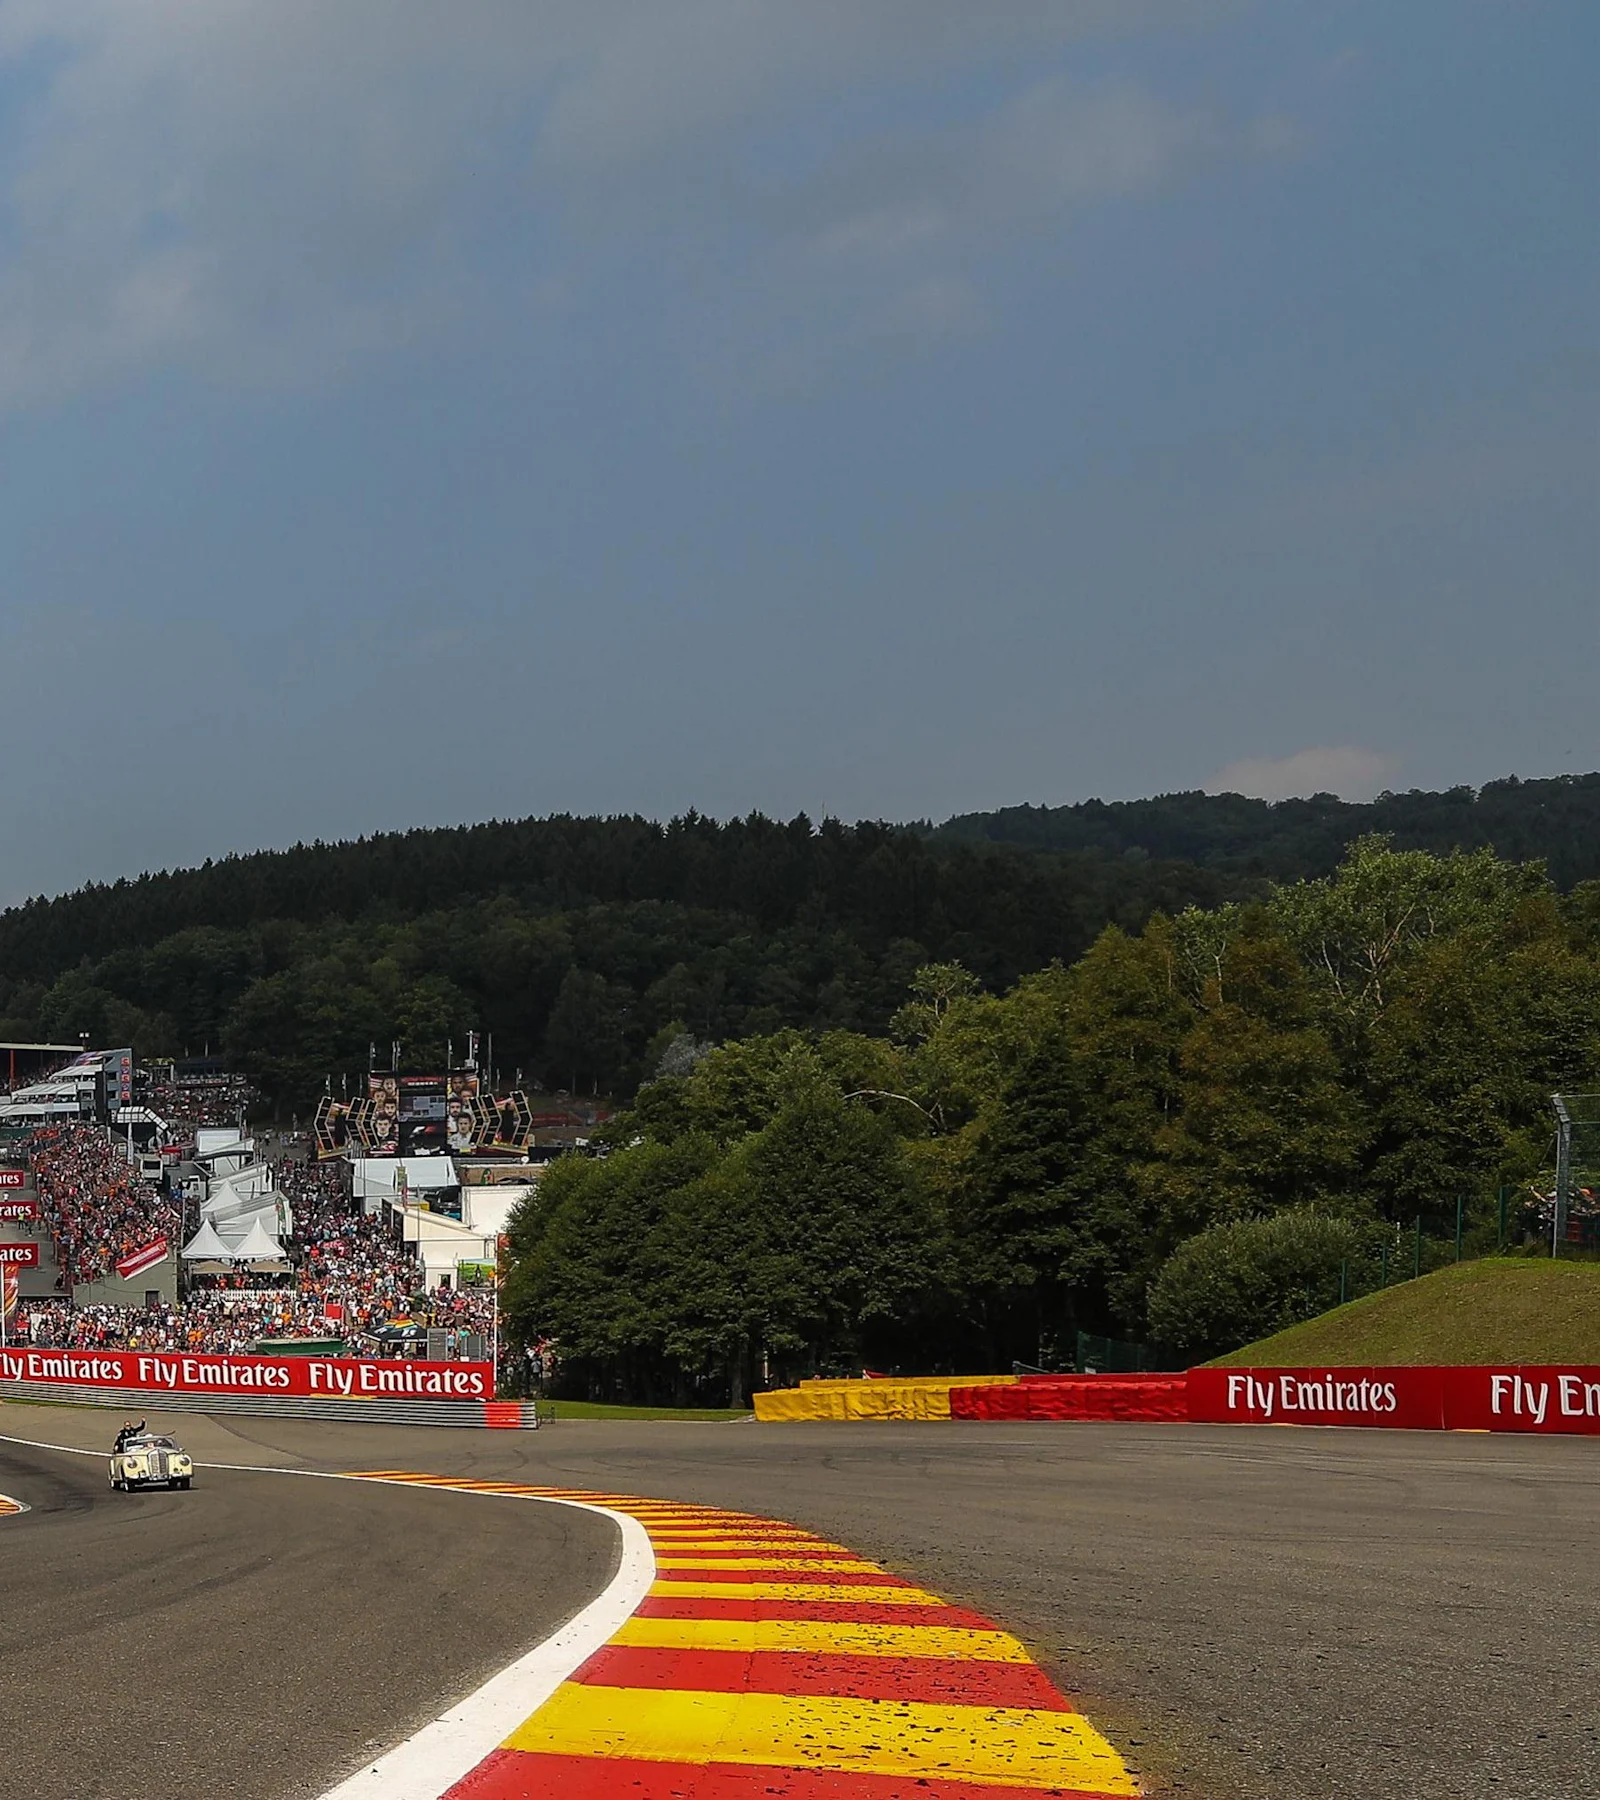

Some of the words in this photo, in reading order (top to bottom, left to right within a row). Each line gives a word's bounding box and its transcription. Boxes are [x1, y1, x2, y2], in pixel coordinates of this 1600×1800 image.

[28, 1352, 123, 1380] Emirates
[138, 1357, 177, 1388] Fly
[182, 1357, 290, 1387] Emirates
[308, 1363, 353, 1395] Fly
[359, 1362, 484, 1394] Emirates
[1227, 1375, 1274, 1417] Fly
[1279, 1373, 1397, 1412] Emirates
[1491, 1375, 1548, 1424] Fly
